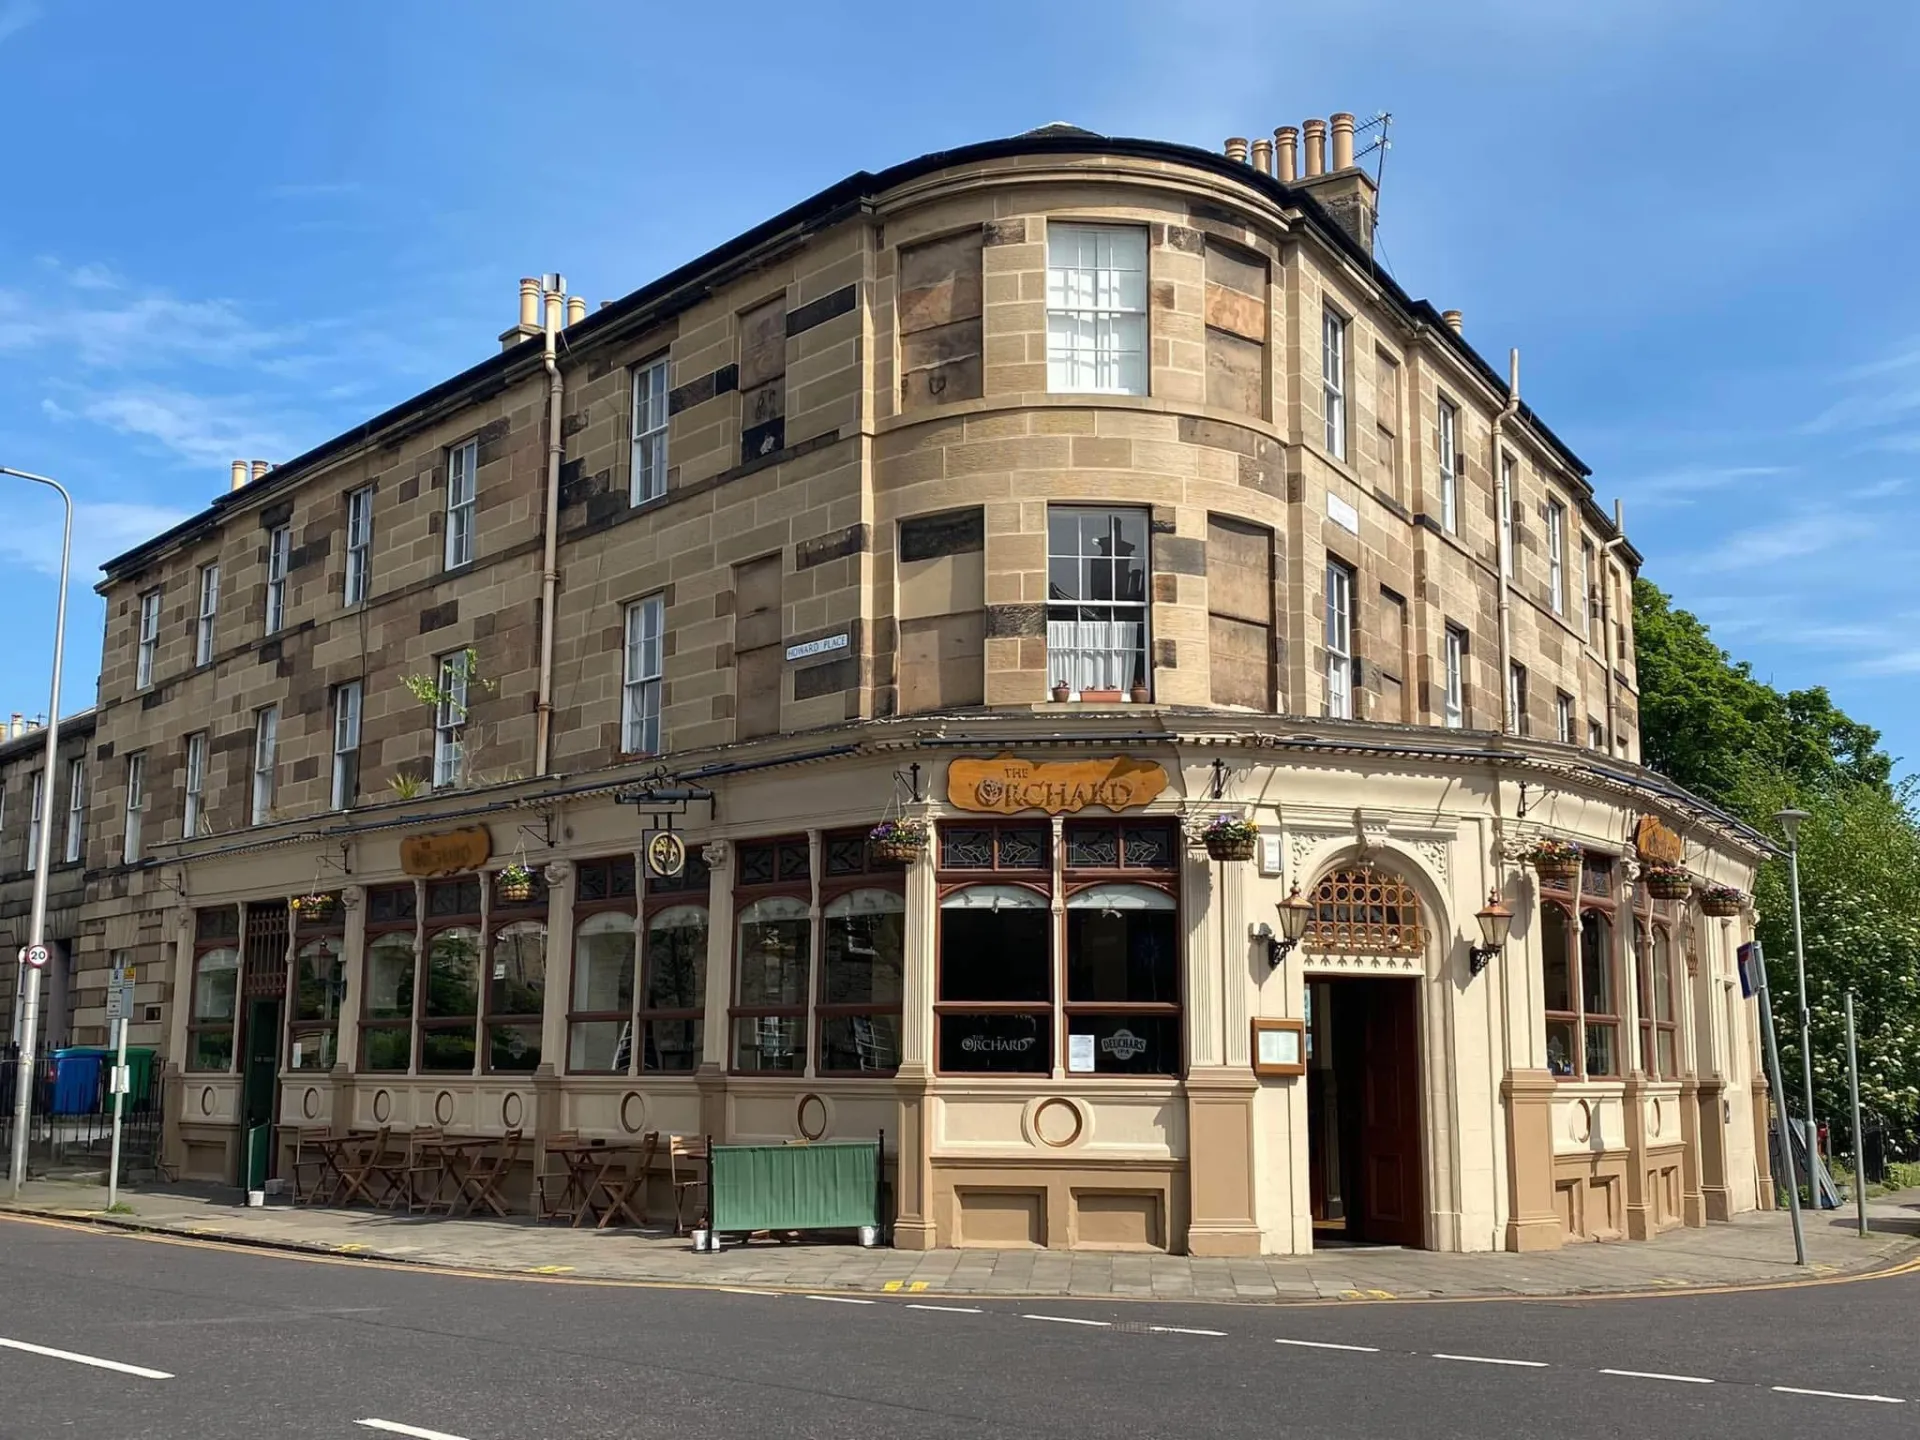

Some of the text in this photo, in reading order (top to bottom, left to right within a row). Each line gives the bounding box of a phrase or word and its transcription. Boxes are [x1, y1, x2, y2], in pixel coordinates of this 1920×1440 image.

[787, 636, 846, 658] HOWARD PLACE
[1004, 767, 1028, 779] THE
[974, 778, 1133, 807] ORCHARD
[31, 951, 46, 960] 20
[961, 1037, 1029, 1052] ORCHARD
